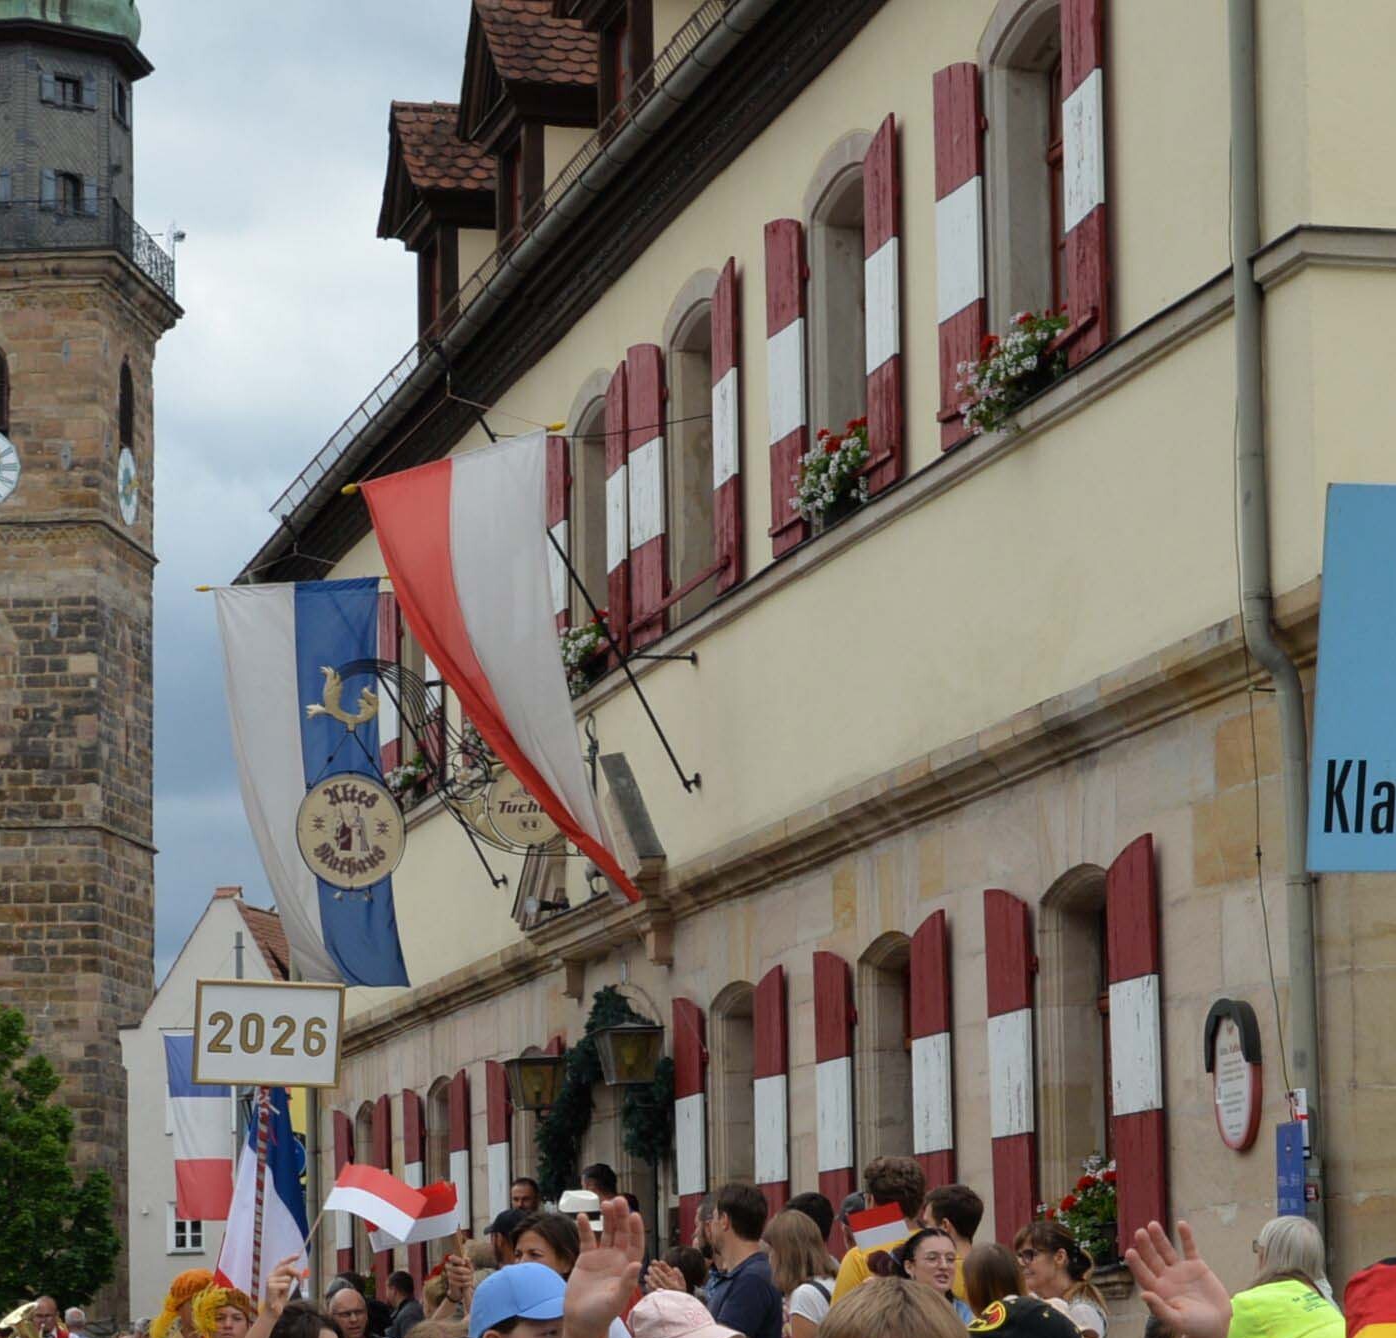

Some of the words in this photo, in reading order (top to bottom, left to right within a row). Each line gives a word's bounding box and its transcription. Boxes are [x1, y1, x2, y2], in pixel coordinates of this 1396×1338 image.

[323, 783, 380, 809] Altes
[497, 799, 547, 814] Tuch
[207, 1010, 329, 1058] 2026
